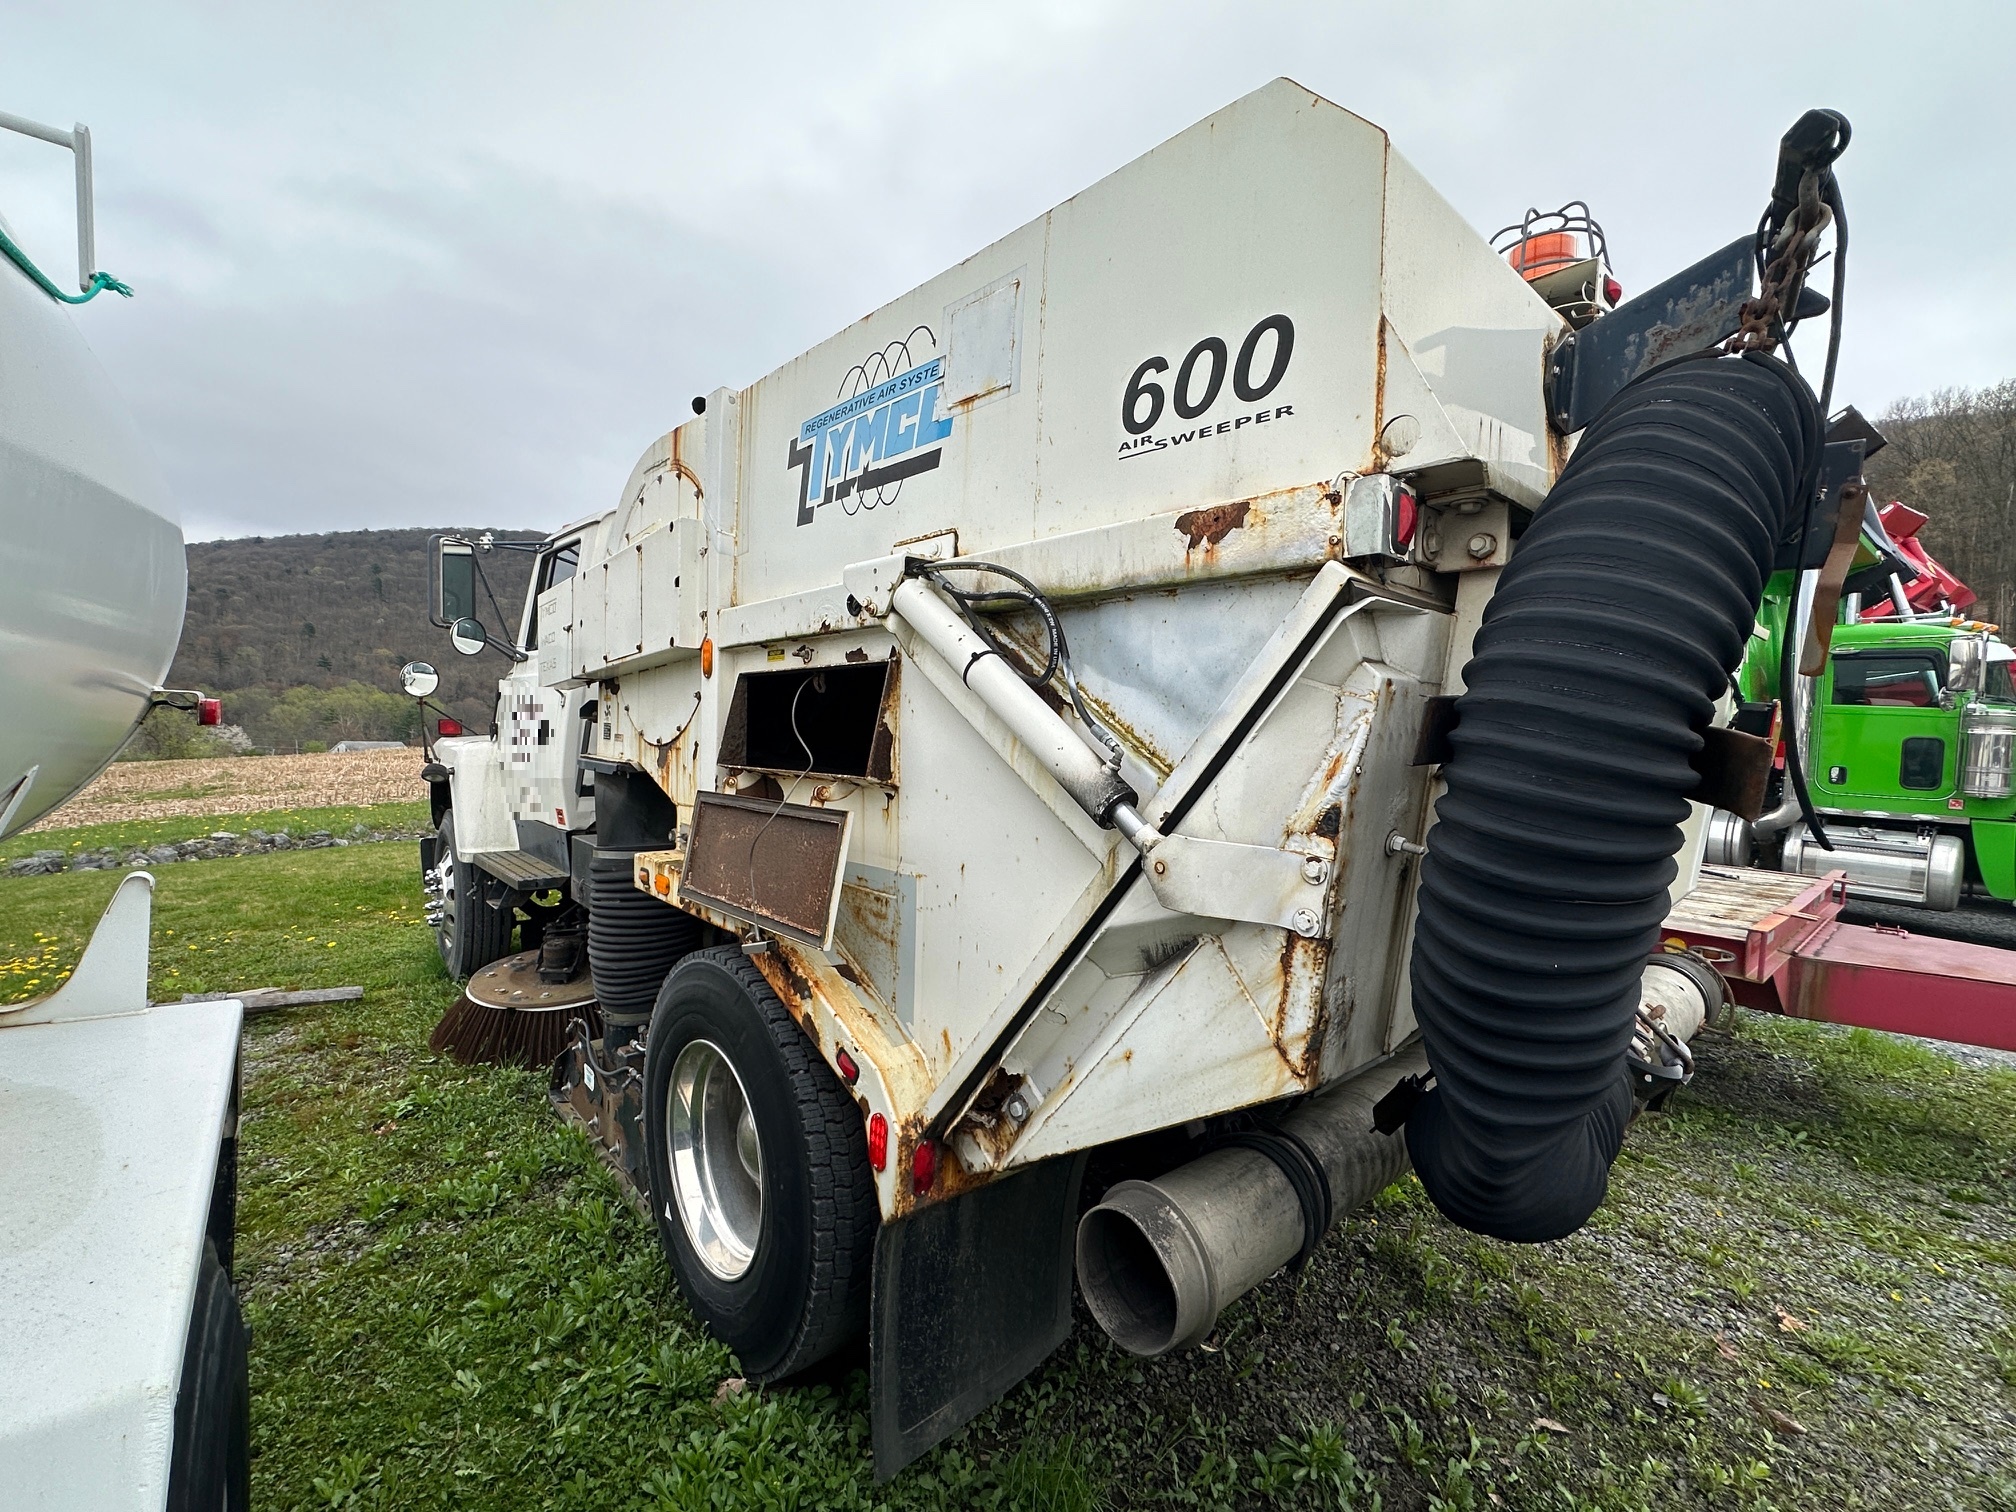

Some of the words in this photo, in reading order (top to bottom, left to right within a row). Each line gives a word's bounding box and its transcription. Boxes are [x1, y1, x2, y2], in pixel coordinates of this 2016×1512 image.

[804, 393, 876, 435] REGENERATIVE
[877, 383, 898, 401] AIR
[899, 363, 940, 390] SYSTE
[1122, 314, 1295, 435] 600
[1118, 435, 1153, 453] AIR
[1154, 405, 1295, 450] SWEEPER
